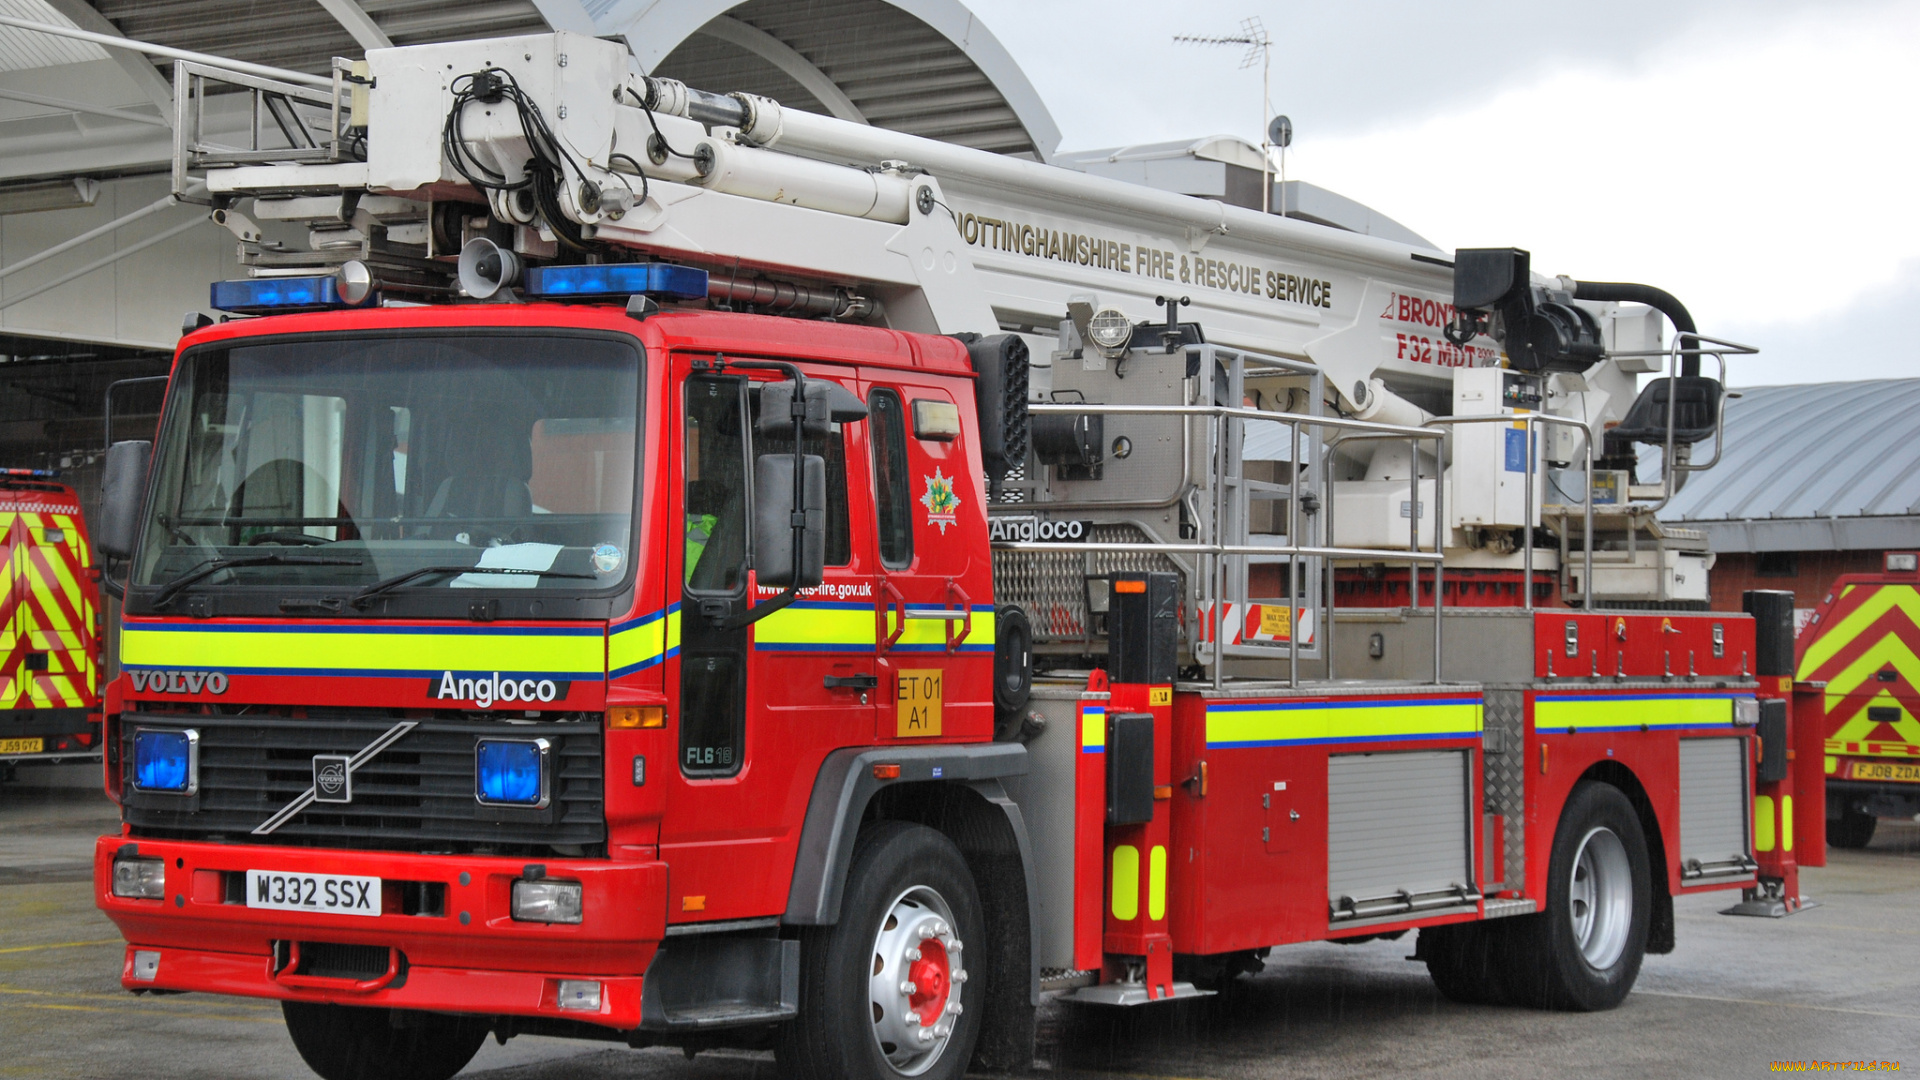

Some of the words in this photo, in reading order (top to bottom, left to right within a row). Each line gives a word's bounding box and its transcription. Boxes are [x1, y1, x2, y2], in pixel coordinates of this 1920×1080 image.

[1136, 246, 1175, 281] FIRE
[1179, 254, 1191, 284] &
[1195, 257, 1261, 296] RESCUE
[1266, 270, 1331, 308] SERVICE
[1436, 340, 1475, 368] MDT
[989, 517, 1083, 543] Angloco
[128, 669, 229, 695] VOLVO
[437, 671, 557, 708] Angloco
[898, 677, 919, 700] ET
[924, 676, 940, 699] 01
[908, 706, 927, 729] A1
[257, 875, 317, 906] W332
[324, 879, 370, 909] SSX
